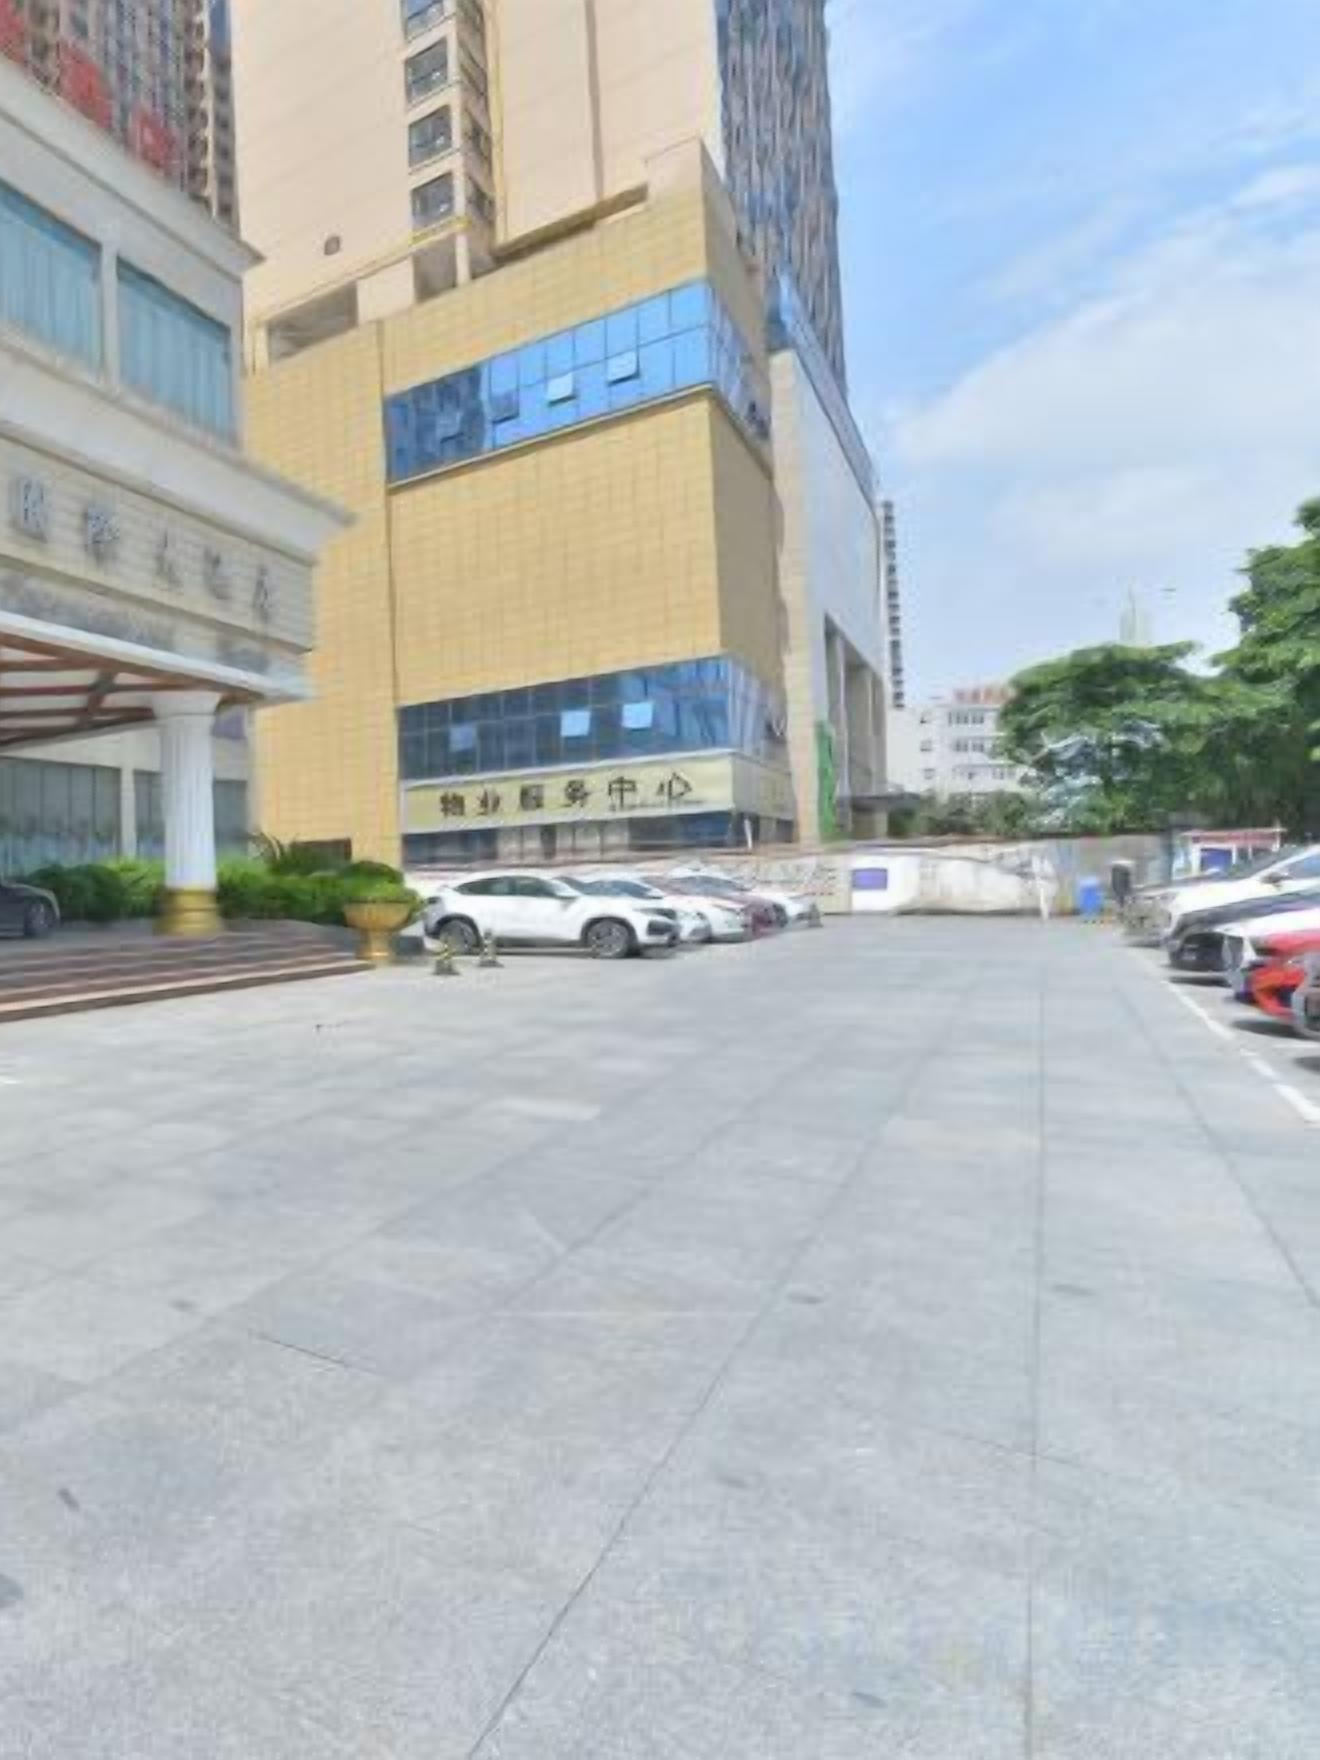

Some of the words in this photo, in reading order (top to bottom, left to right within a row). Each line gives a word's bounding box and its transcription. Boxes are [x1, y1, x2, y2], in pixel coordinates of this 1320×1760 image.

[438, 772, 693, 818] 物业服务中心
